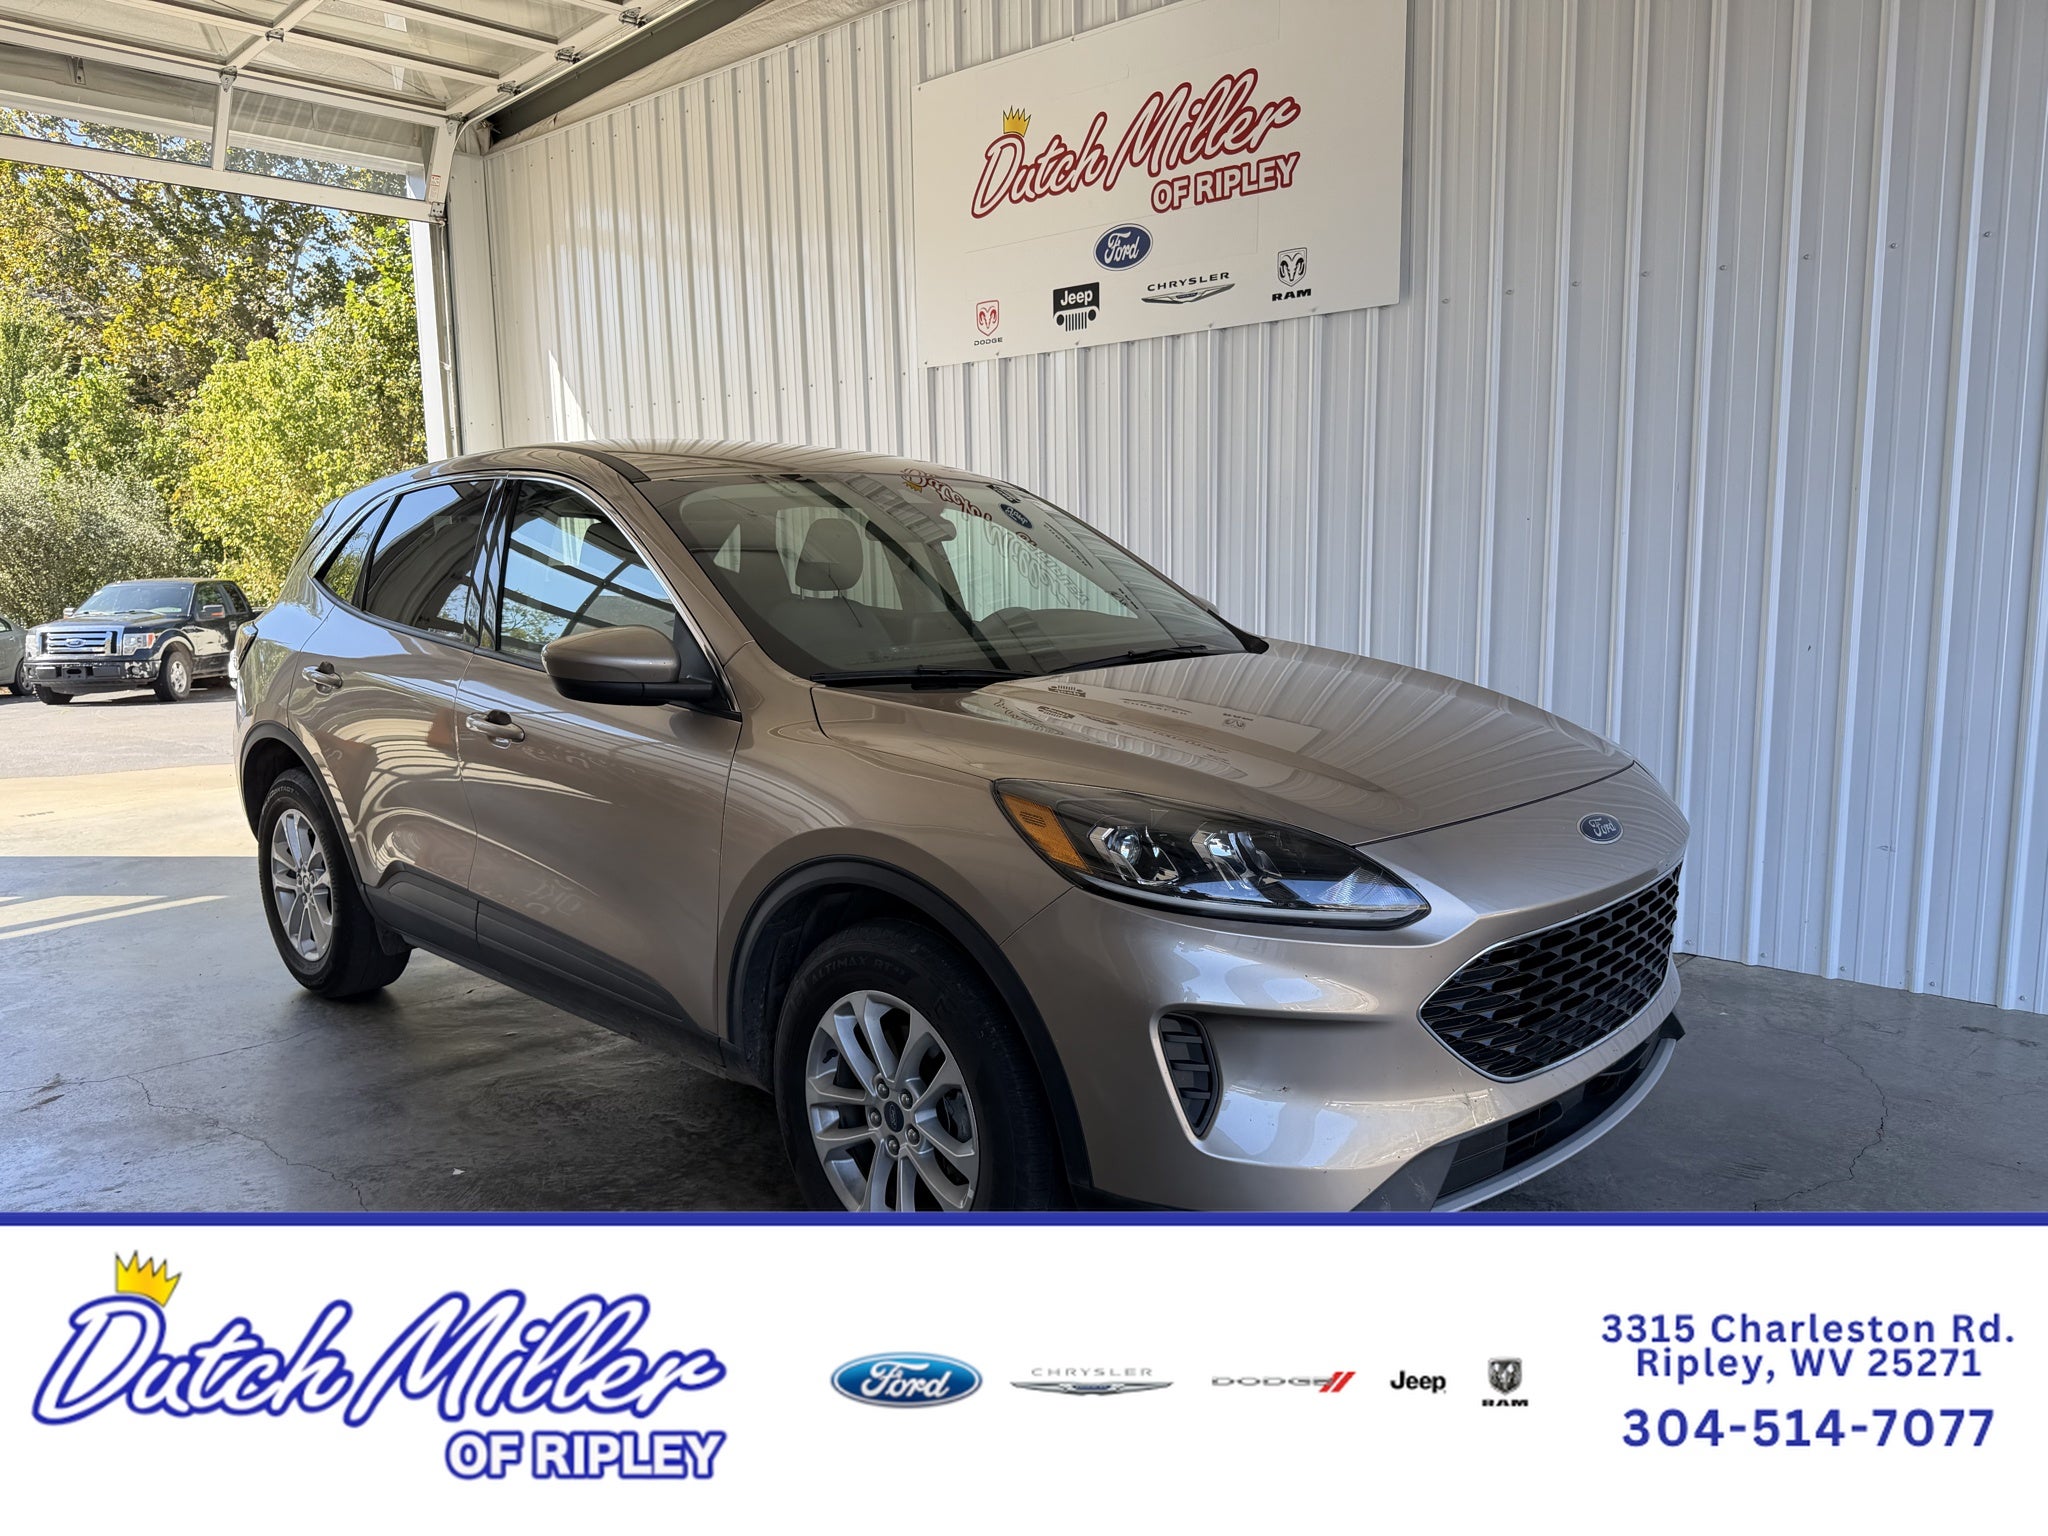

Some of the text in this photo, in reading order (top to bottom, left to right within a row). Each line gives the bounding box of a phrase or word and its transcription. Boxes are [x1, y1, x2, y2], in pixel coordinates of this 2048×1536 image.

[971, 67, 1302, 219] Dutch Miller
[1150, 151, 1301, 214] OF RIPLEY
[1103, 231, 1140, 261] Ford
[1147, 272, 1230, 292] CHRYSLER
[1060, 288, 1094, 307] Jeep
[1271, 288, 1312, 302] RAM
[973, 337, 1004, 346] DODGE
[1588, 818, 1616, 836] Ford
